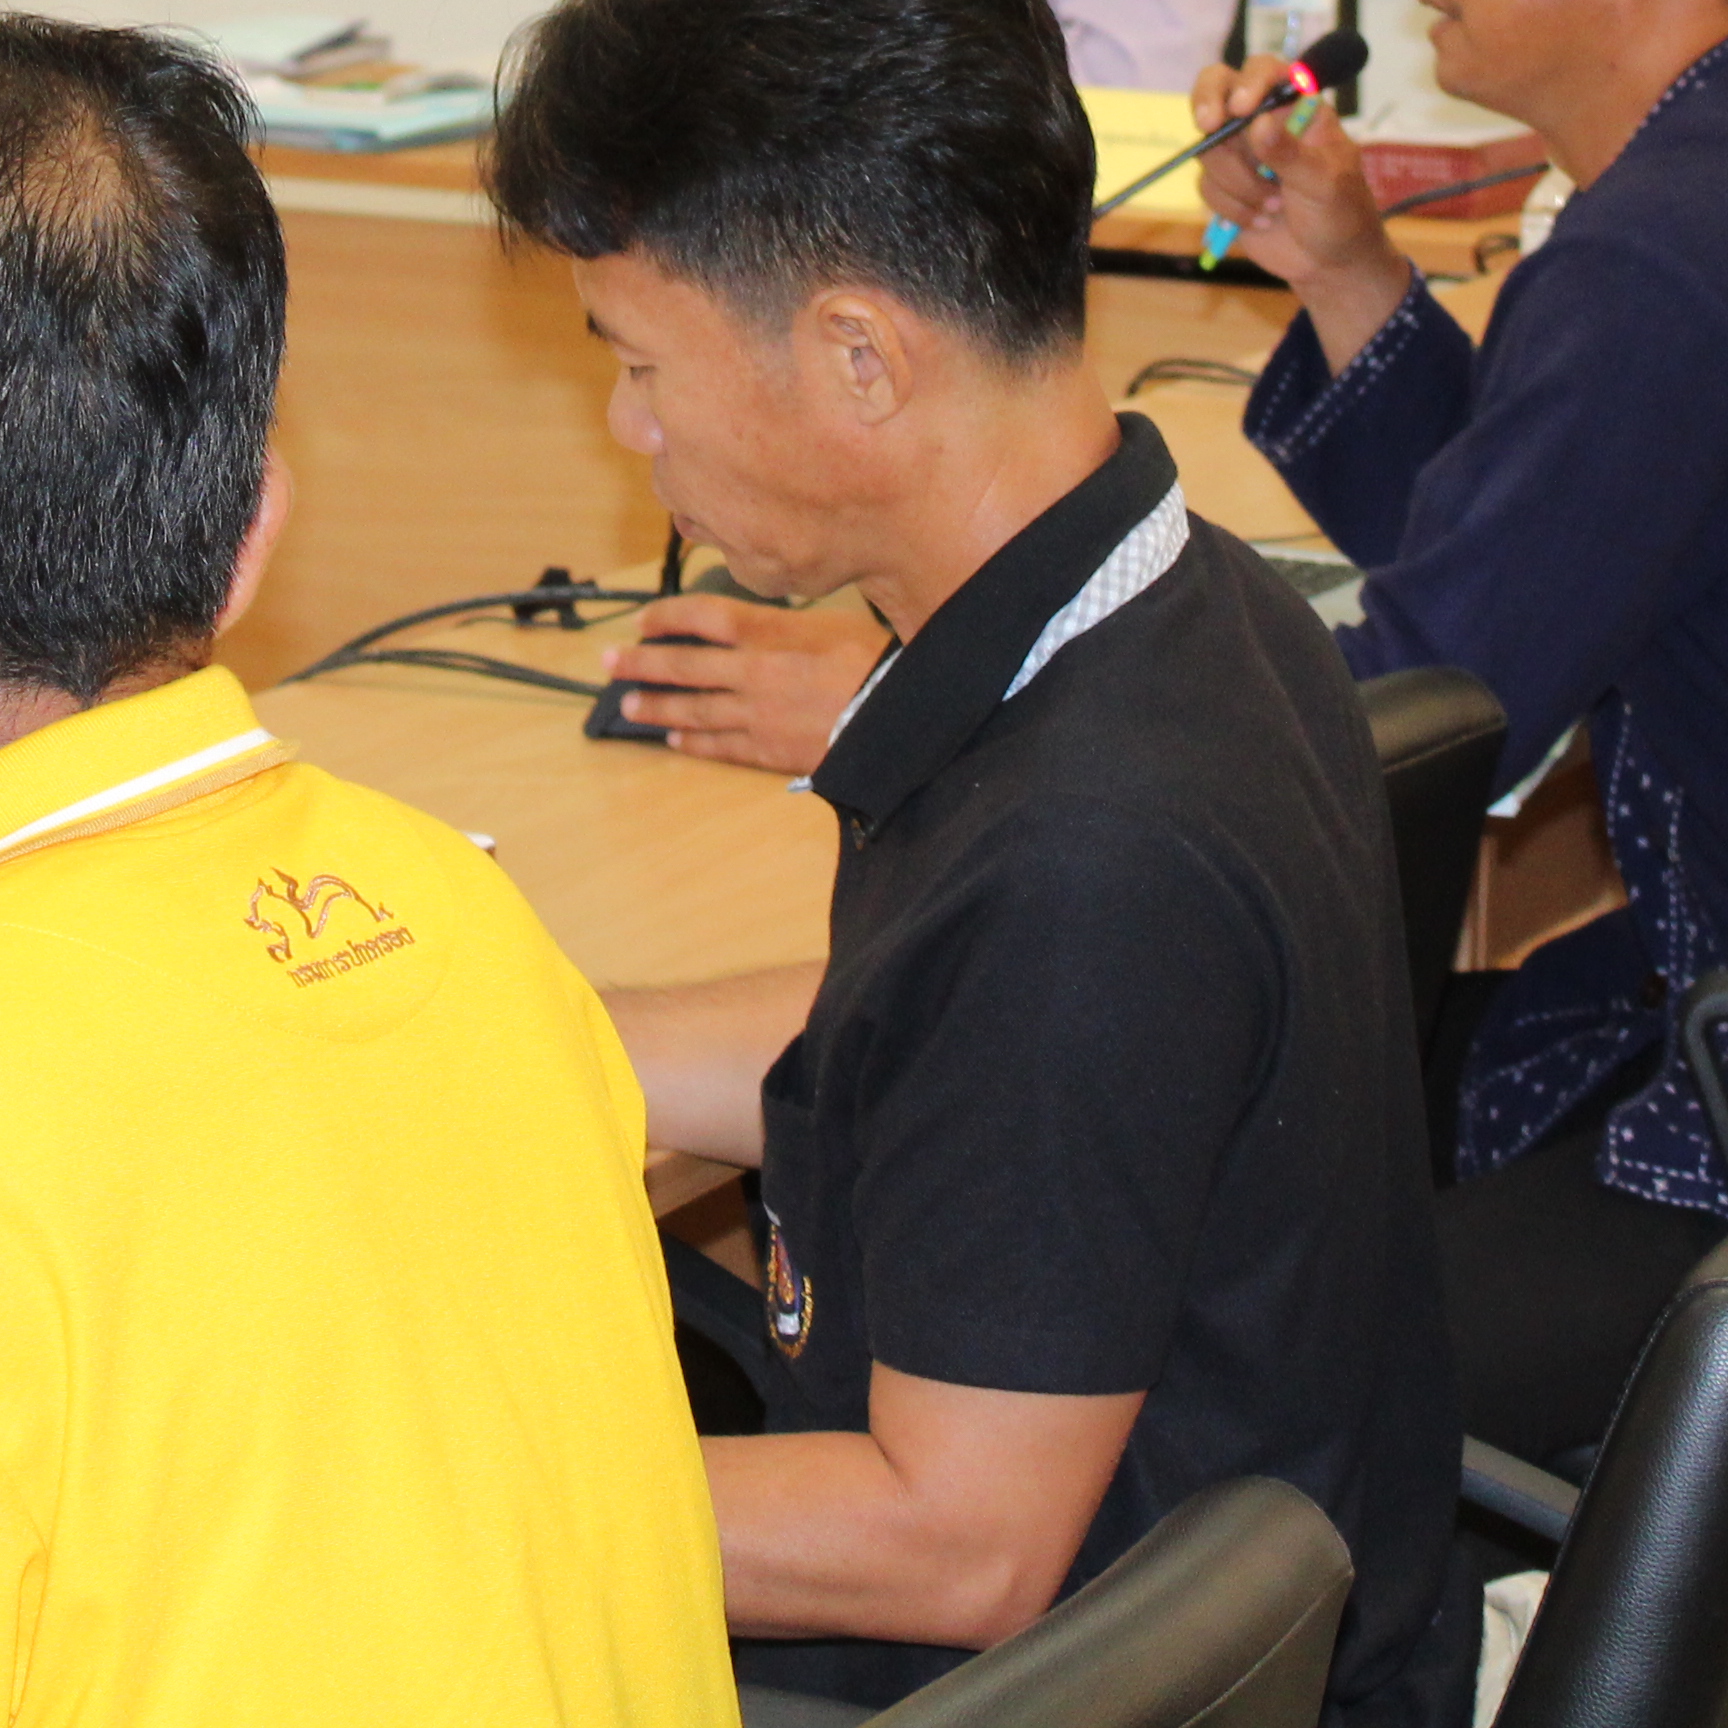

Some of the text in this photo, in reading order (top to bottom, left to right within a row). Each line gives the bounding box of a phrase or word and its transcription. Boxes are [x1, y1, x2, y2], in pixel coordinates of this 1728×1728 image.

[286, 926, 415, 988] กรมการปกครอง
